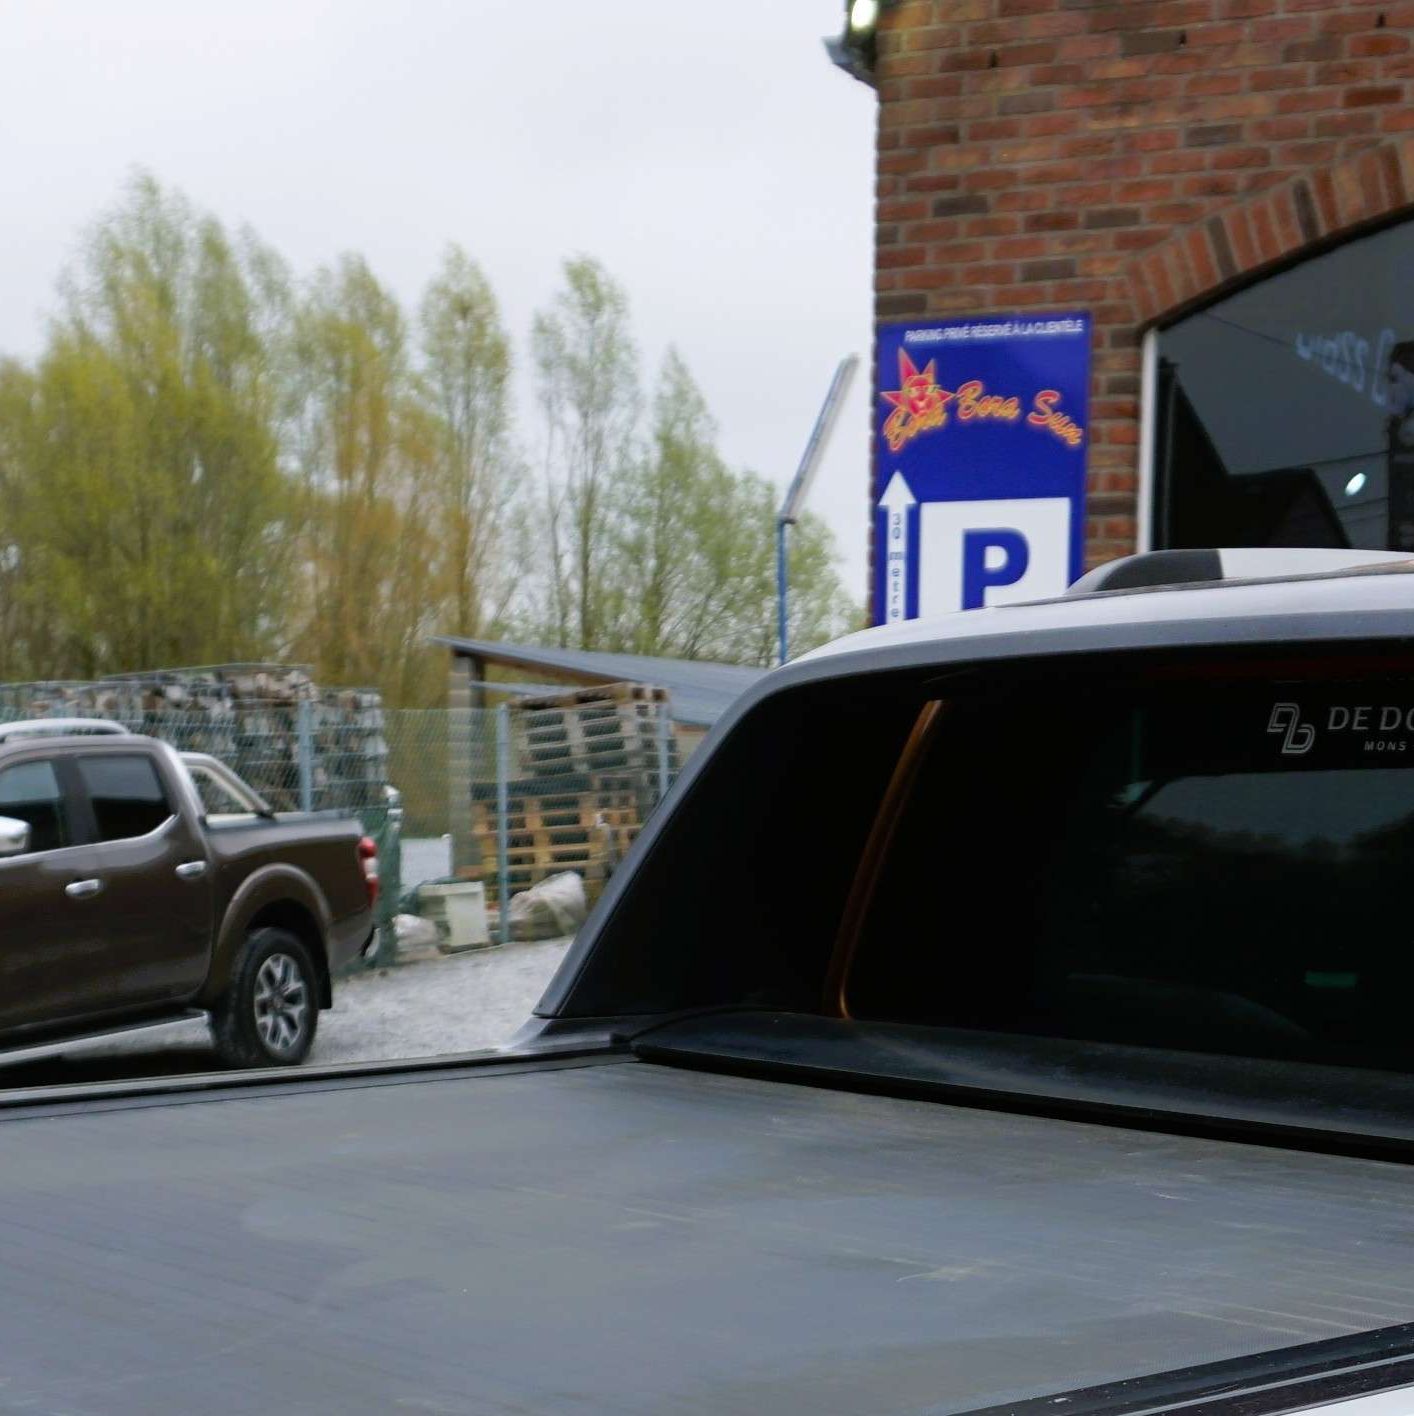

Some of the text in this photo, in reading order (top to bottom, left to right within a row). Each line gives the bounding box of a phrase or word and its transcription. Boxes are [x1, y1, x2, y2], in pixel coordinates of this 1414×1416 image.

[961, 527, 1030, 611] P
[1327, 705, 1372, 731] DE
[1364, 740, 1407, 752] MONS
